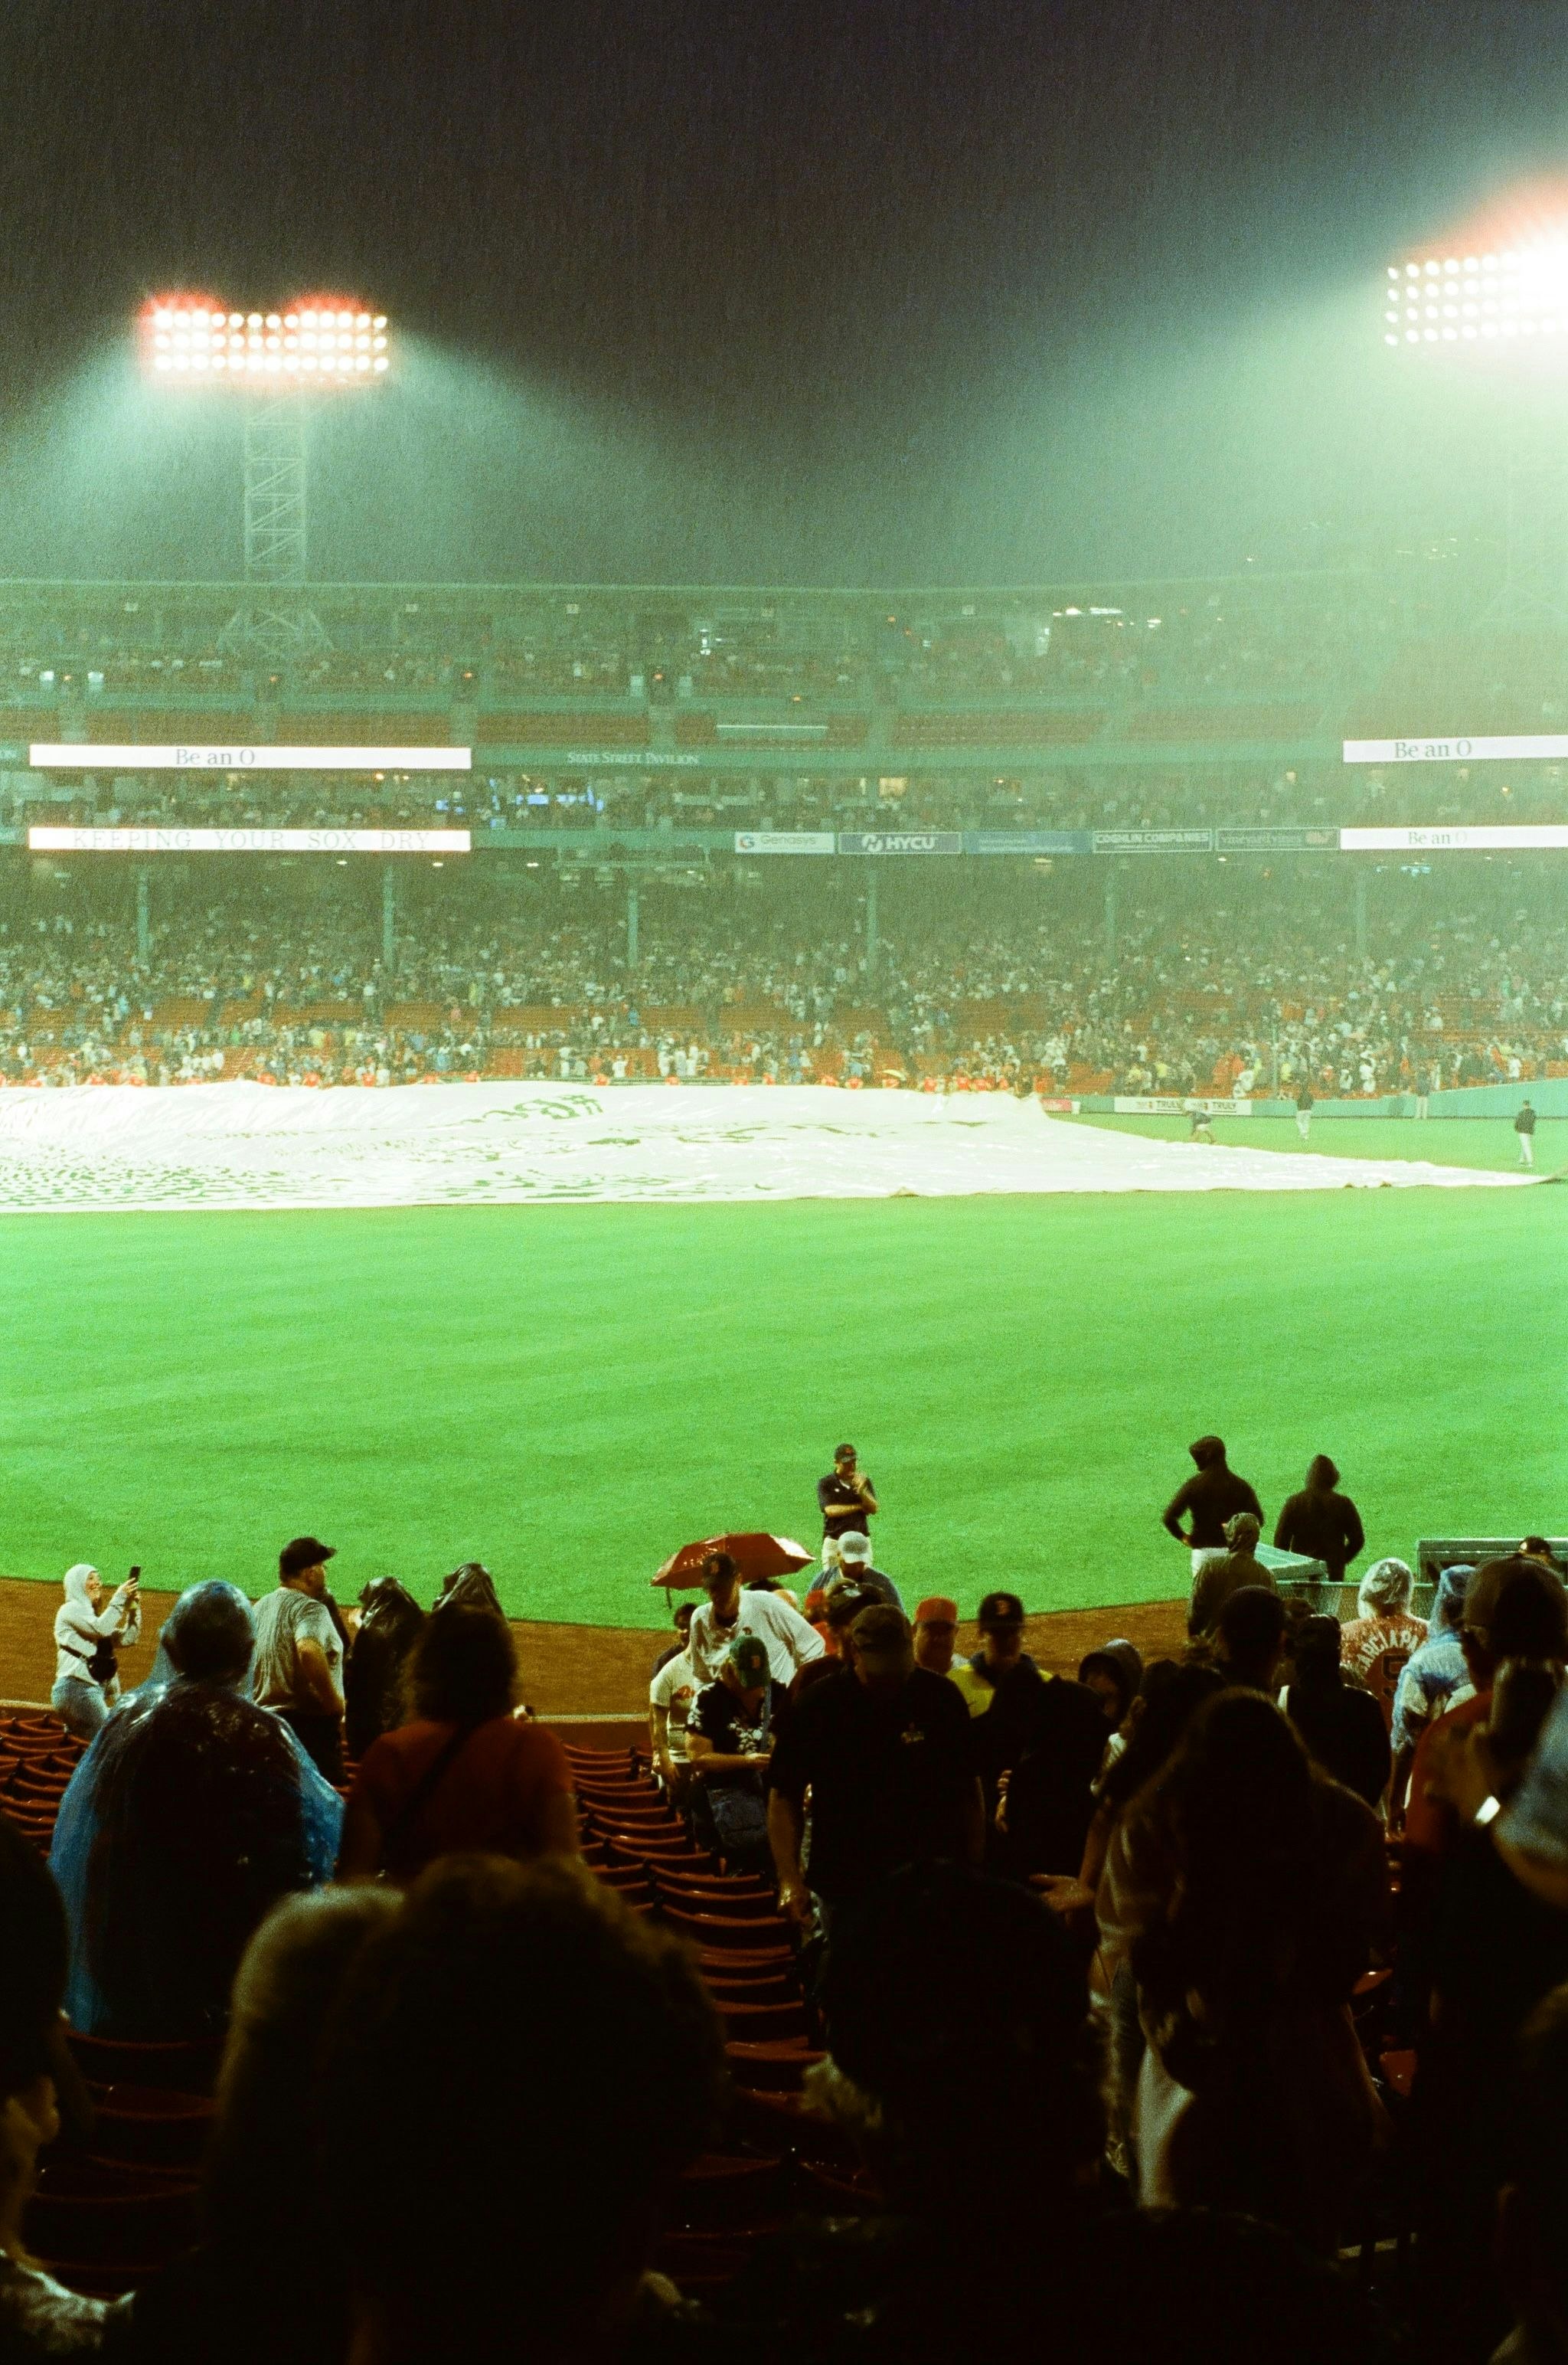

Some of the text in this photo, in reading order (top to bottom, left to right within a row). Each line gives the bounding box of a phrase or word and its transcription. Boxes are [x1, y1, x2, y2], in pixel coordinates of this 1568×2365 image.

[1395, 739, 1472, 758] Be an O
[176, 748, 255, 766] Be an O
[74, 830, 429, 849] KEEPING YOUR SOX DRY
[886, 836, 936, 849] HYCU
[1408, 831, 1426, 844] Be
[1432, 833, 1450, 844] an
[1212, 1101, 1237, 1110] TRULY
